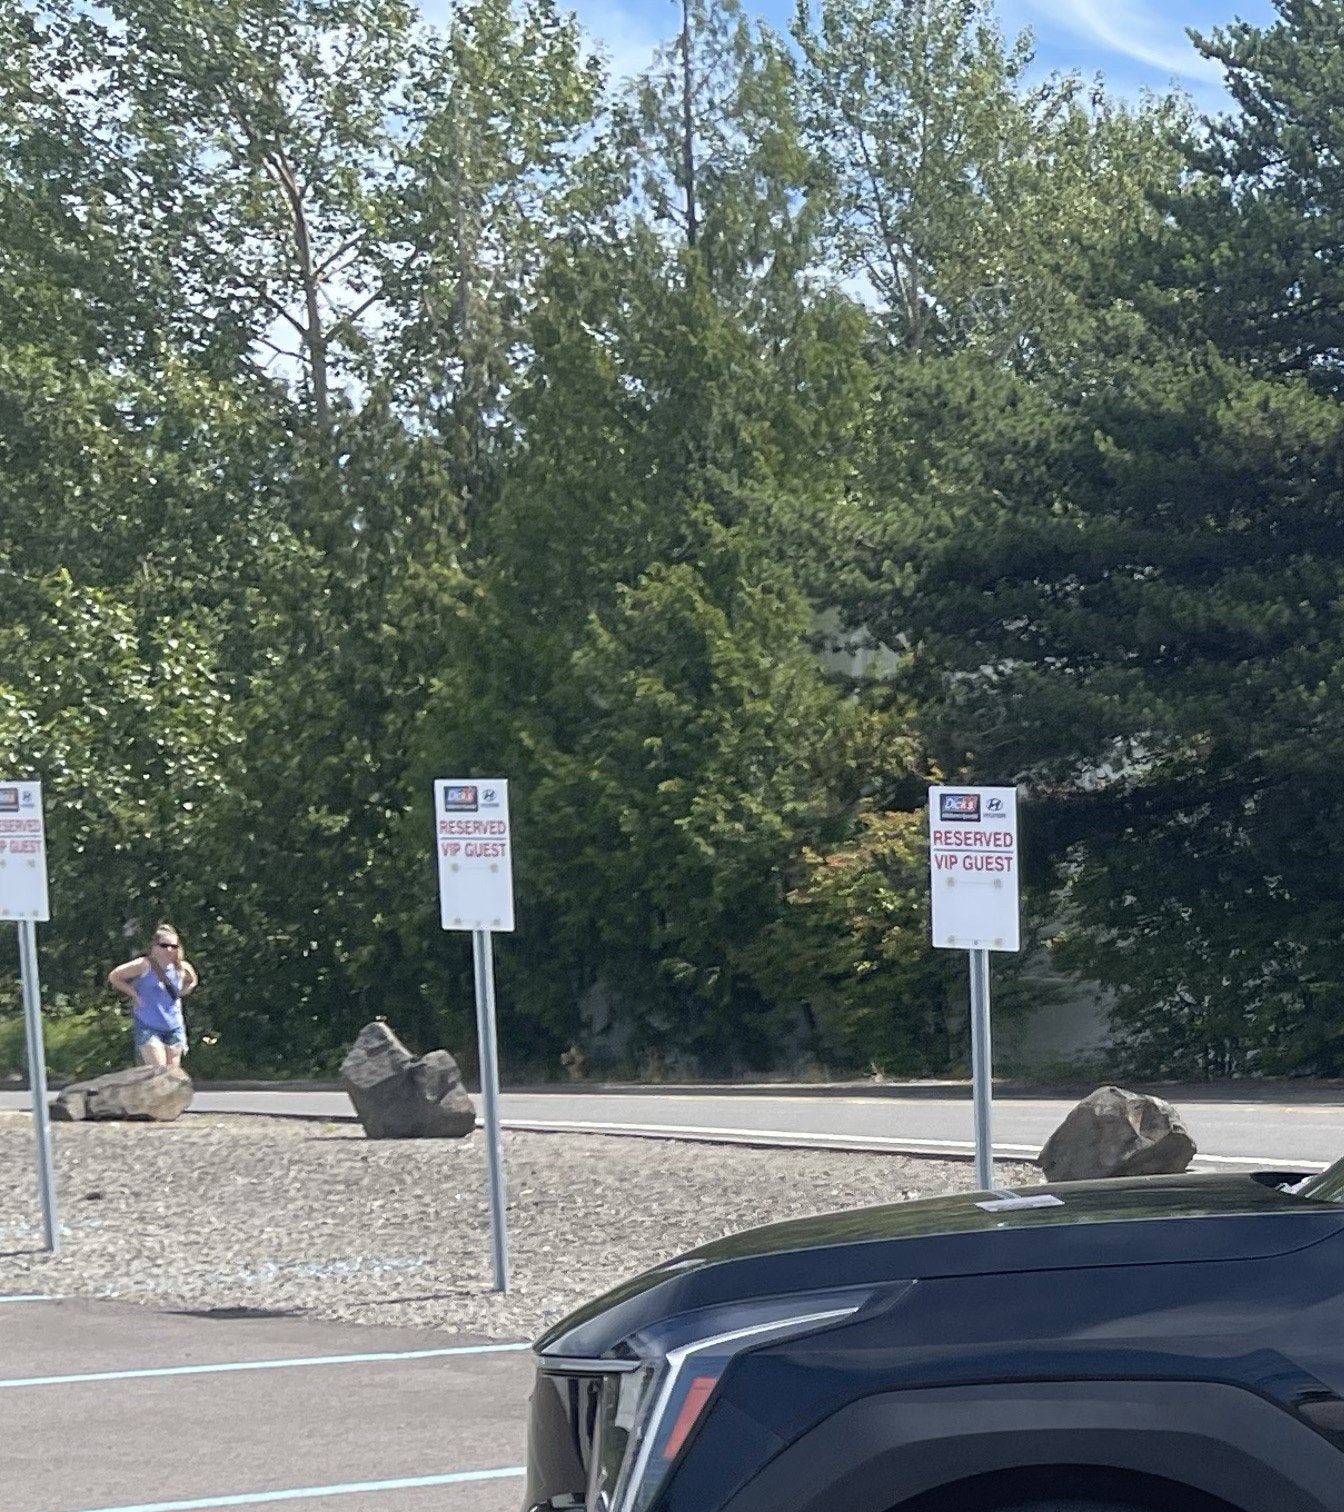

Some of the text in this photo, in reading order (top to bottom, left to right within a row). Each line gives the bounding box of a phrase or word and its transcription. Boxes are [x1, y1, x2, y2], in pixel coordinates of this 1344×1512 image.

[439, 820, 507, 835] RESERVED
[933, 830, 1013, 847] RESERVED
[465, 842, 506, 857] GUEST
[934, 855, 1013, 872] VIP GUEST
